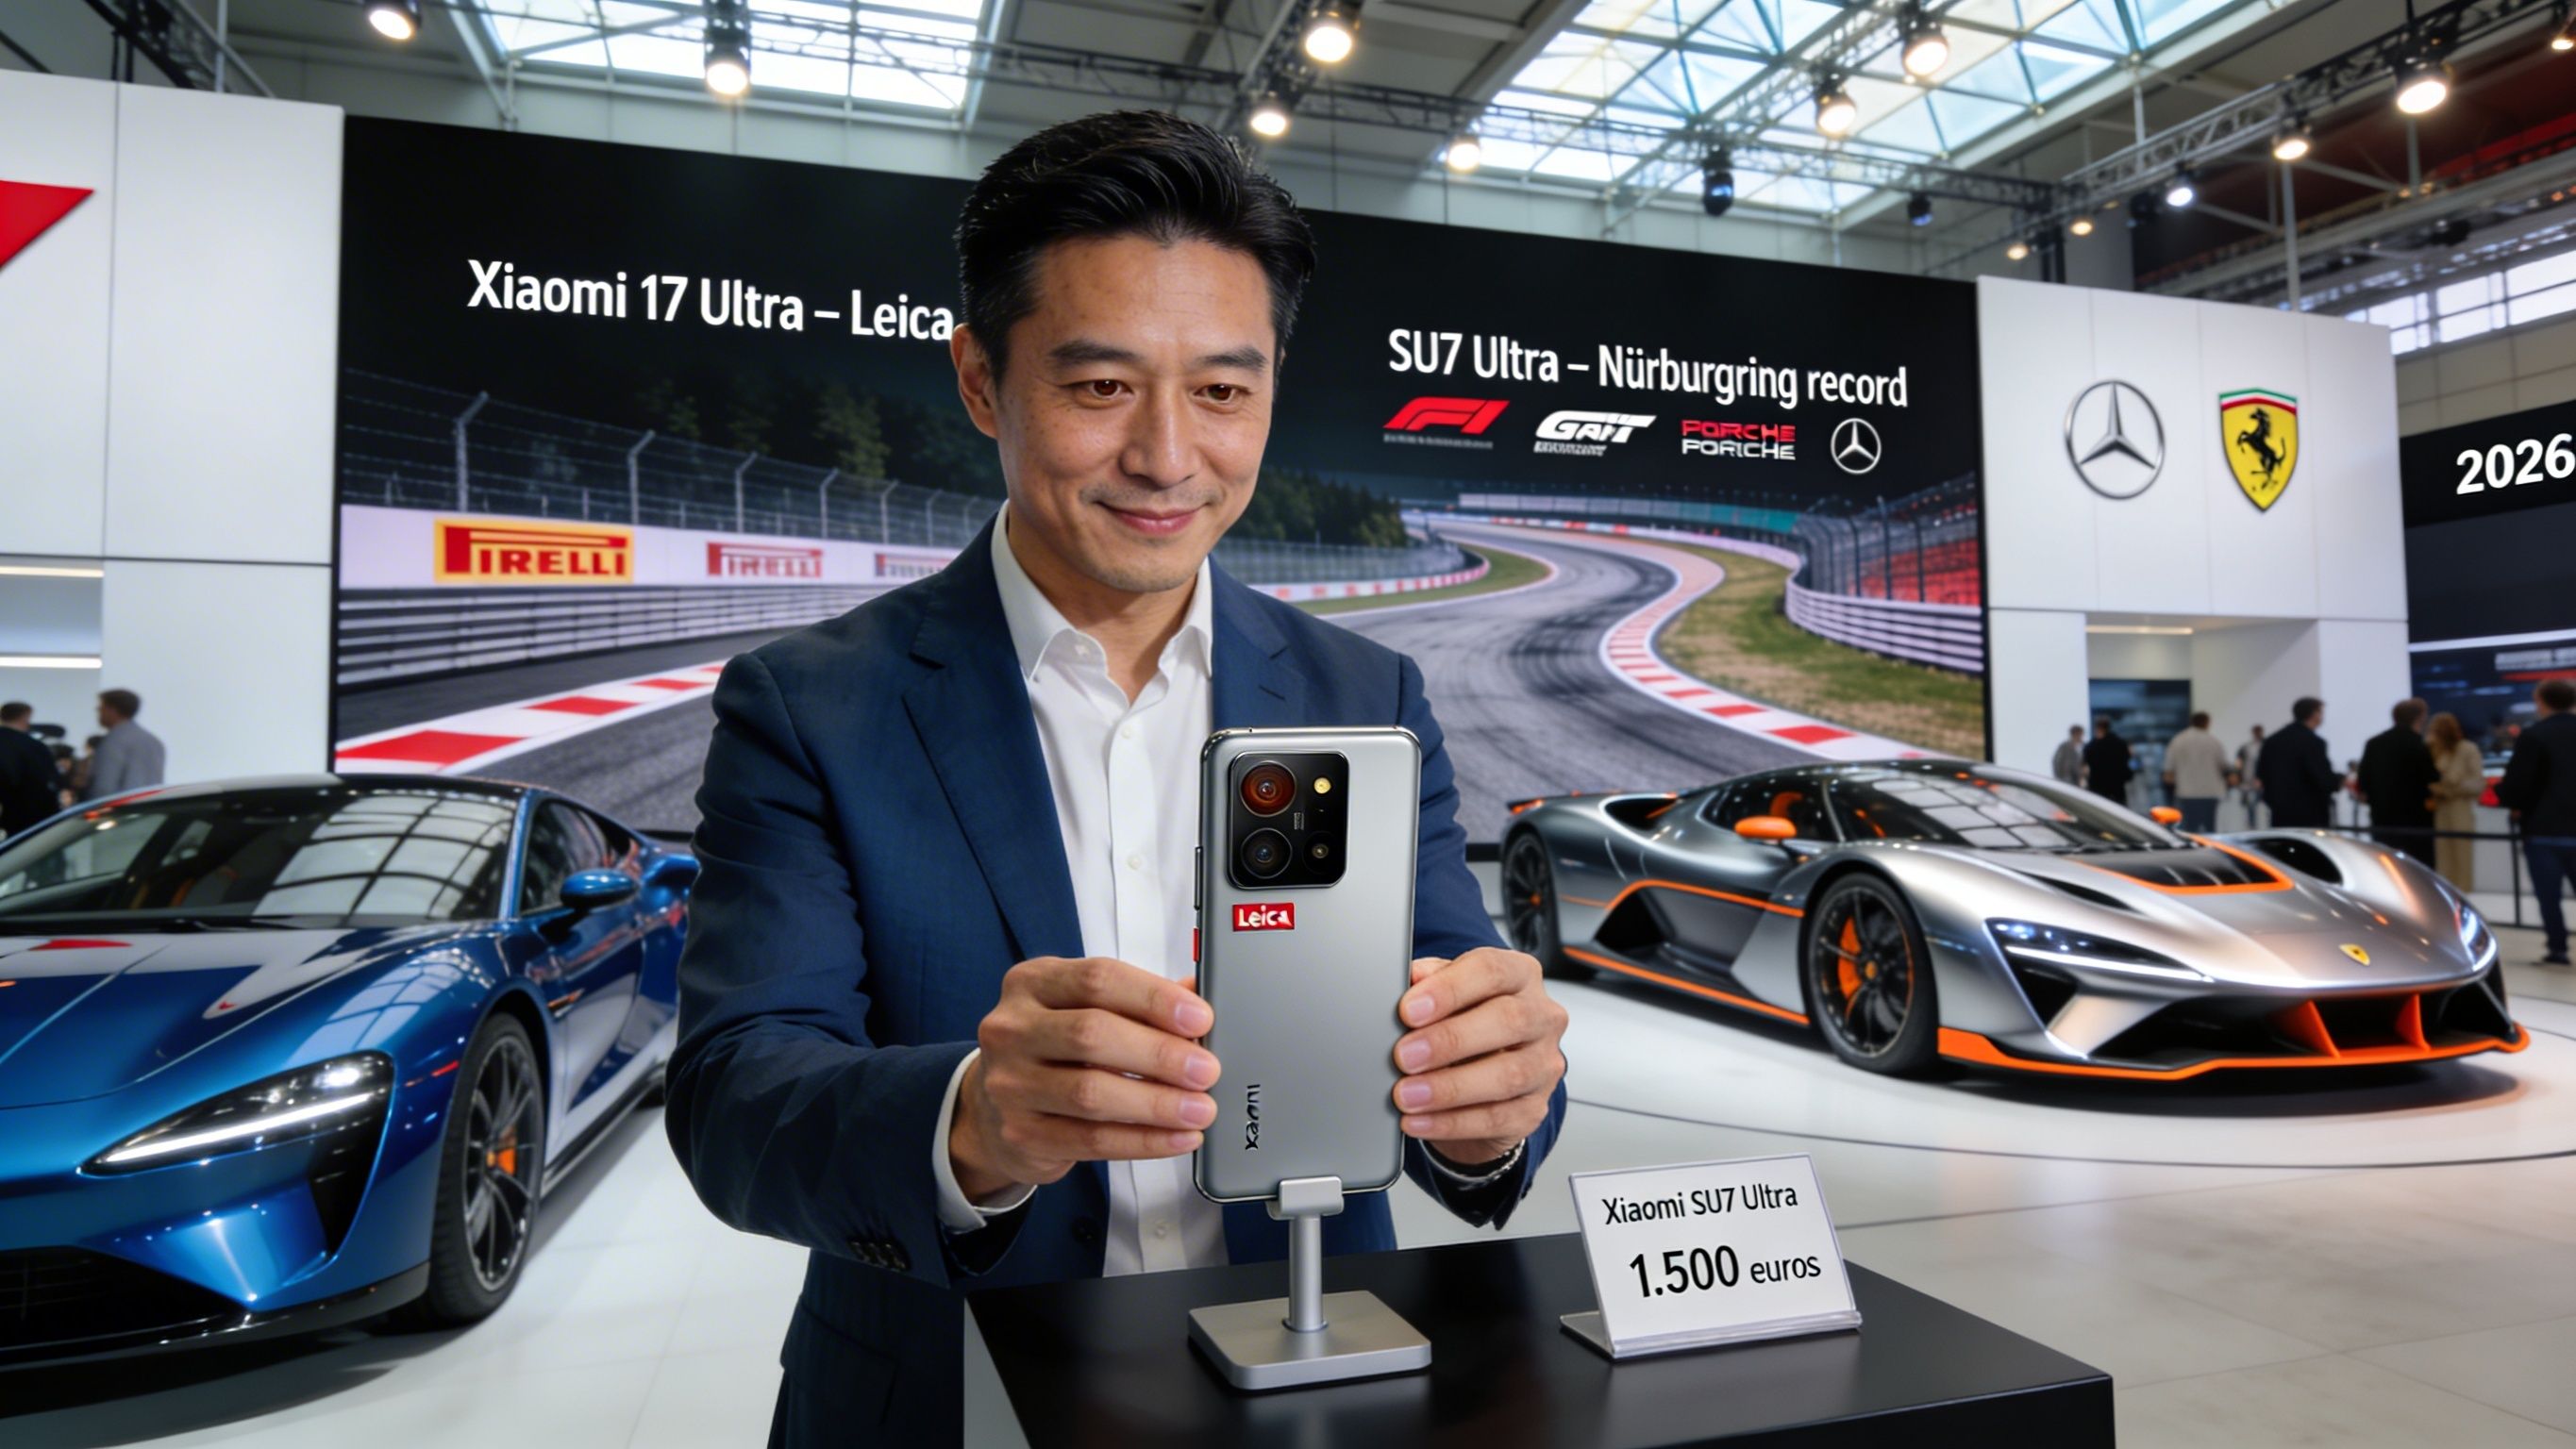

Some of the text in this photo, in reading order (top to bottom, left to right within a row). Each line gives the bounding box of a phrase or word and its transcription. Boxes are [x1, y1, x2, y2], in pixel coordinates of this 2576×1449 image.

[467, 258, 628, 319] Xiaomi
[640, 274, 689, 322] 17
[699, 277, 804, 332] Ultra
[850, 289, 954, 341] Leica
[1388, 328, 1464, 375] SU7
[1473, 334, 1560, 383] Ultra
[1597, 344, 1798, 410] Nürburgring
[1806, 366, 1909, 408] record
[2456, 433, 2576, 495] 2026
[443, 525, 629, 575] PIRELLI
[1237, 904, 1294, 928] Leica
[1601, 1183, 1798, 1225] Xiaomi SU7 Ultra
[1629, 1245, 1822, 1298] 1.500 euros
